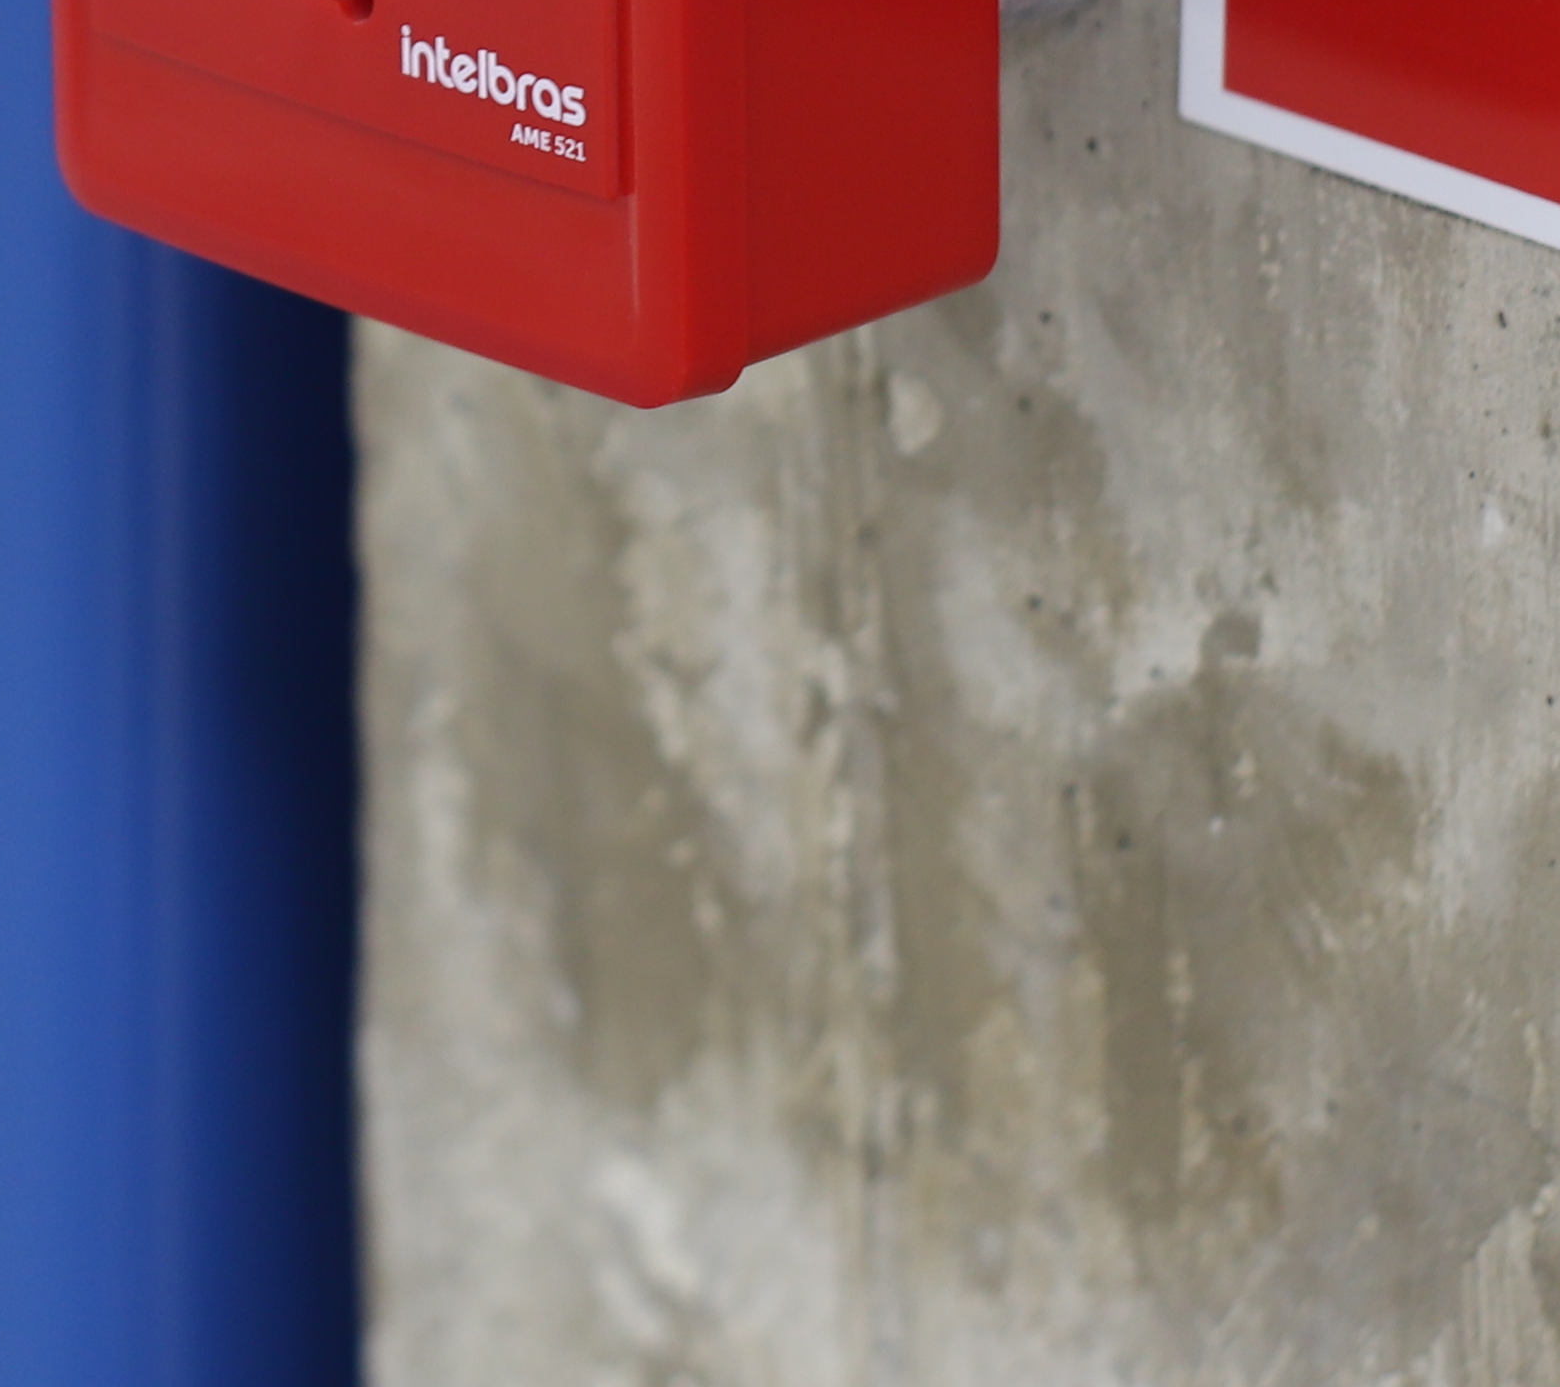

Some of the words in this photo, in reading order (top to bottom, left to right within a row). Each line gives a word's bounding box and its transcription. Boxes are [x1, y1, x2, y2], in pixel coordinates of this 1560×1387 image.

[400, 24, 588, 127] intelbras
[510, 123, 553, 153] AME
[554, 135, 587, 163] 521
